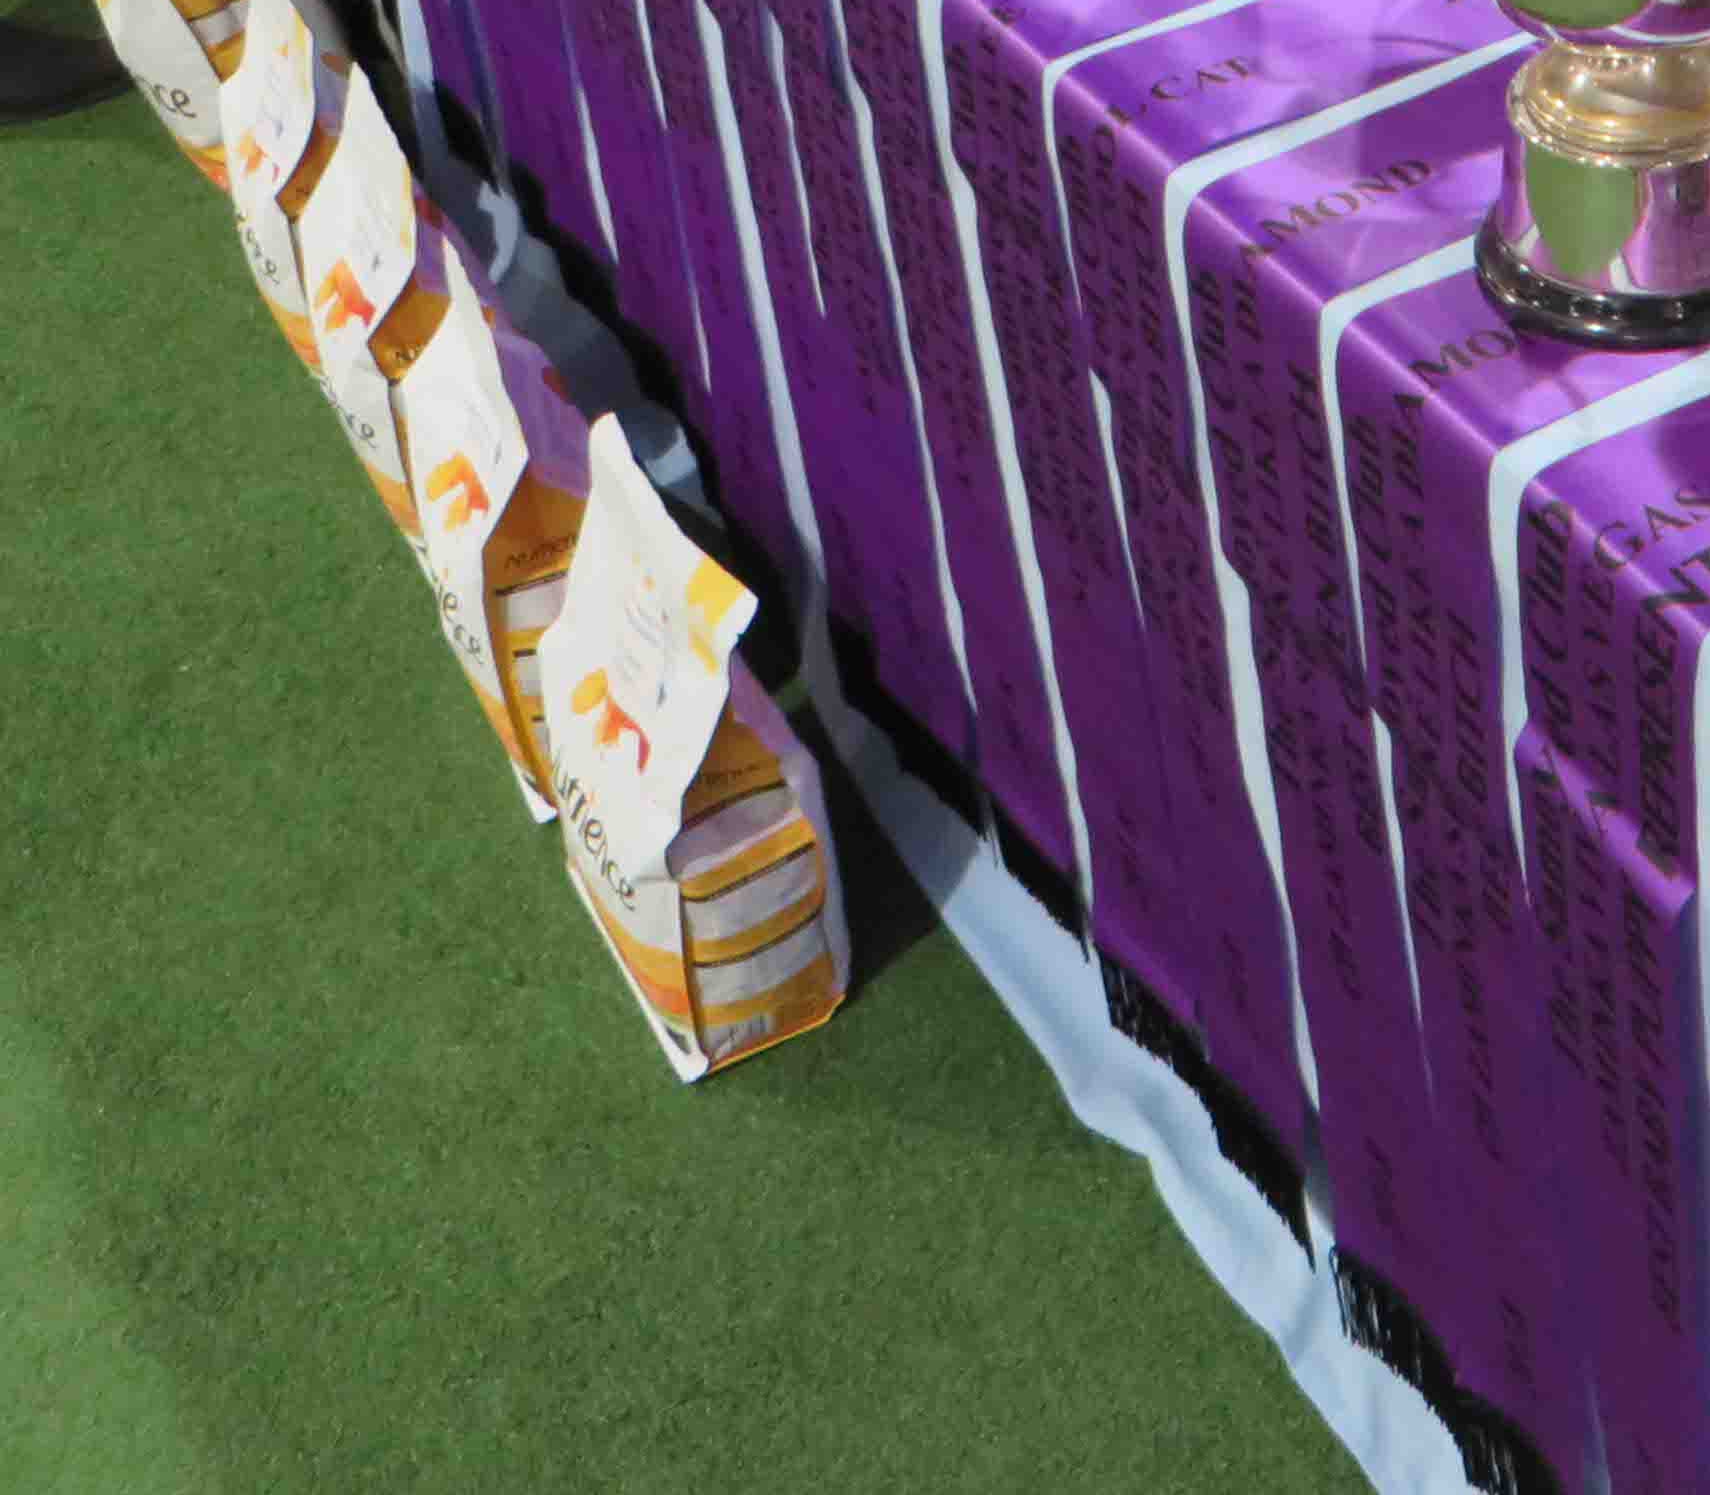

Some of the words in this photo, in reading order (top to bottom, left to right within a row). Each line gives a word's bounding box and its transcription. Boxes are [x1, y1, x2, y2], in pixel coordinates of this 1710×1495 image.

[1233, 157, 1433, 347] DIAMOND
[1349, 413, 1393, 563] Club
[1521, 499, 1573, 663] Club
